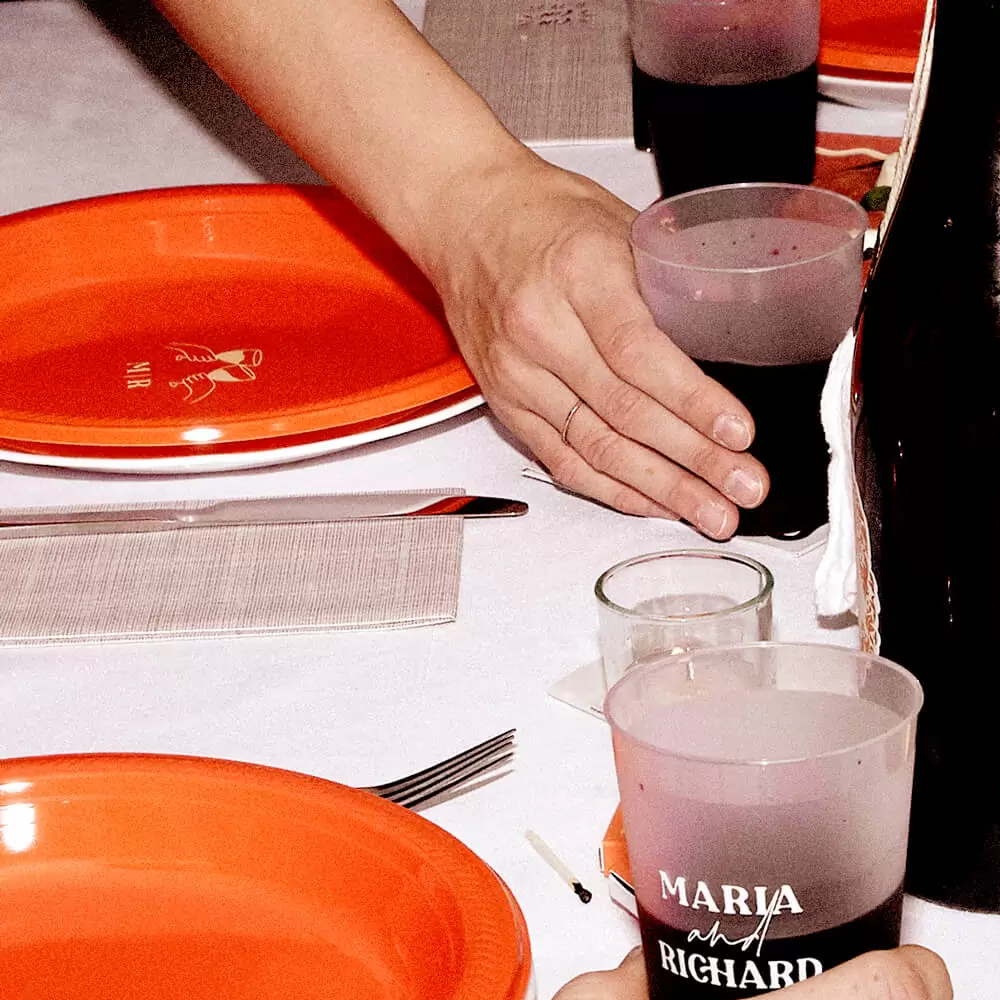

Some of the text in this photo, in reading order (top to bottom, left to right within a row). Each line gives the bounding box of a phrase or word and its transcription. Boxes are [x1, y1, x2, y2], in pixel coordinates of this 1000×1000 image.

[658, 869, 804, 916] MARIA
[687, 888, 781, 958] and
[658, 939, 824, 990] RICHARD
